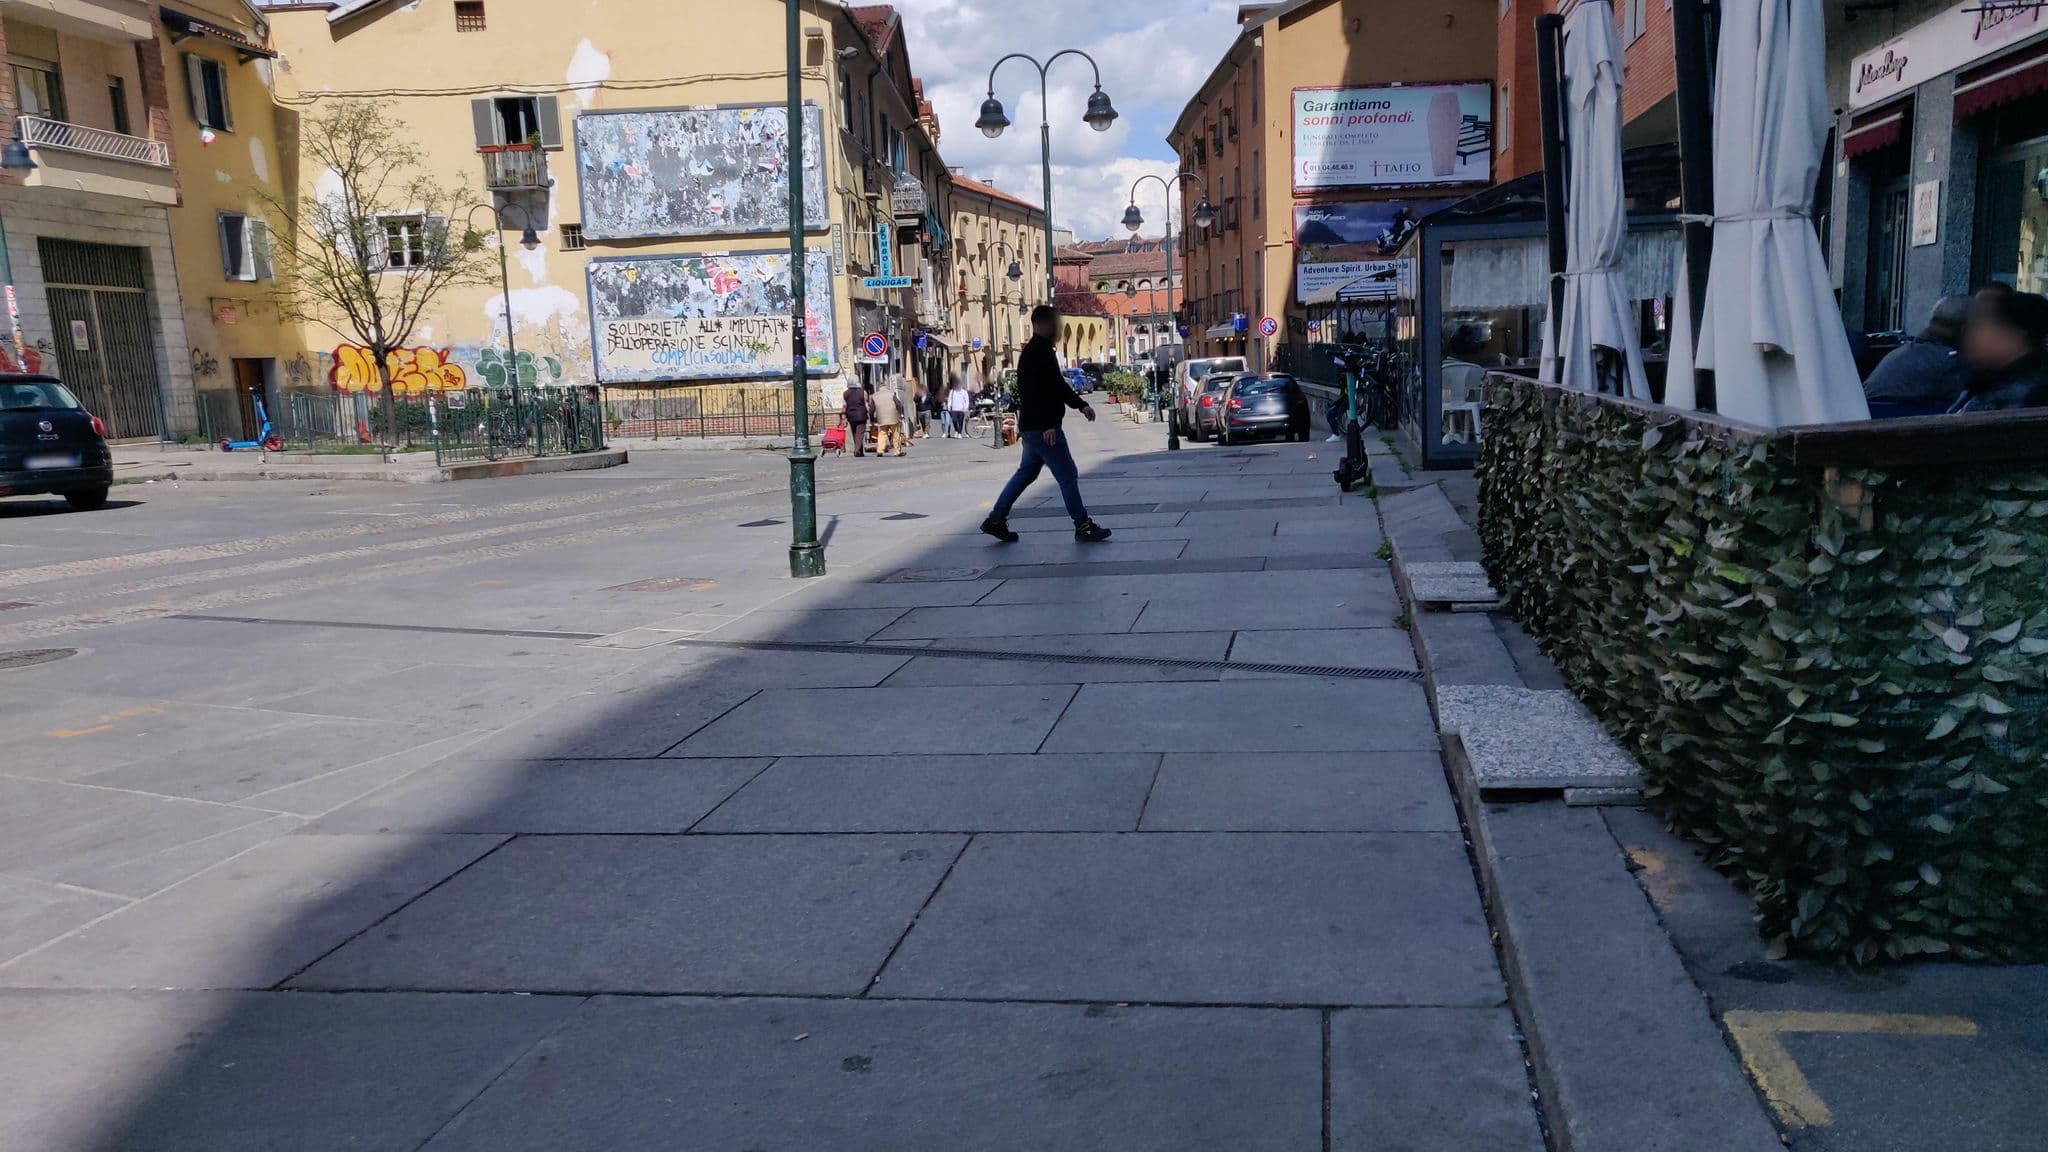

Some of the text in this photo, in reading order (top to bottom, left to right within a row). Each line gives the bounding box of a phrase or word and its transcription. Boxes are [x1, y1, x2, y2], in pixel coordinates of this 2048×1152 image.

[1303, 99, 1391, 112] Garantiamo
[1303, 111, 1415, 127] sonni profondi.
[1304, 265, 1339, 274] Adventure
[1365, 263, 1385, 271] Urban
[867, 279, 907, 287] LIQUIGAS
